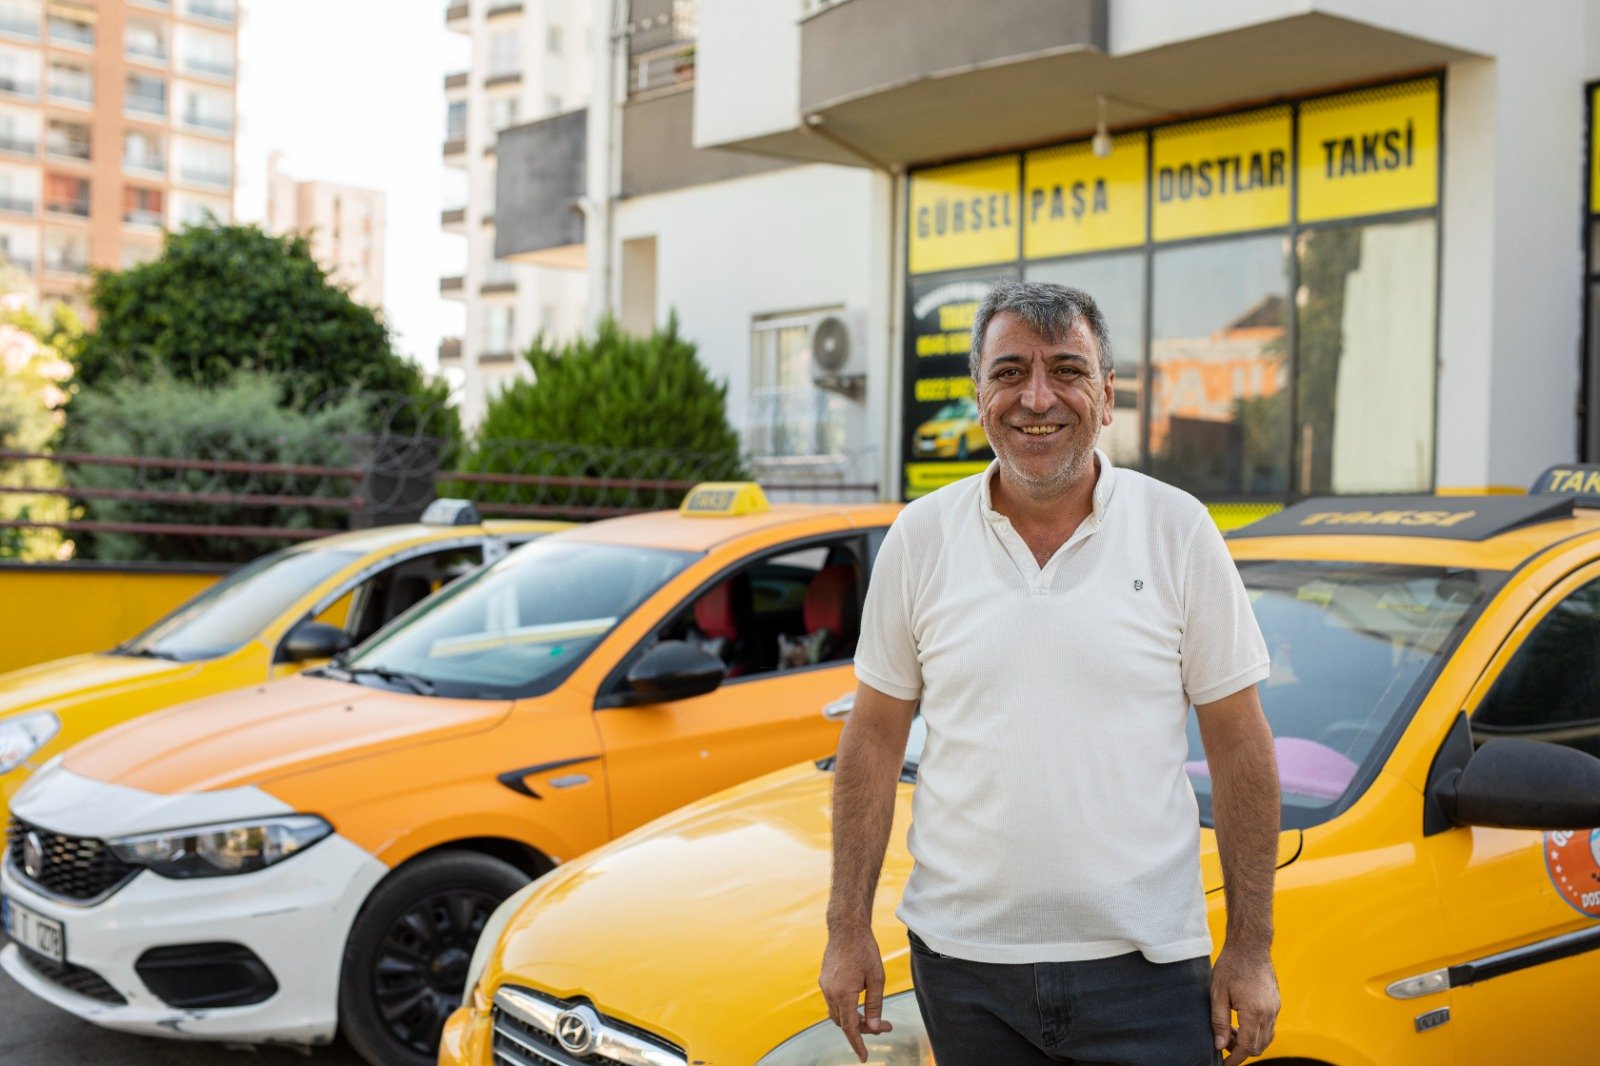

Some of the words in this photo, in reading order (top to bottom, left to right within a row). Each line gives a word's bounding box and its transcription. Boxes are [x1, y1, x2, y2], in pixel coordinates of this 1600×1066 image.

[917, 192, 1012, 239] GÜRSEL
[1031, 179, 1108, 224] PAŞA
[1158, 149, 1286, 203] DOSTLAR
[1321, 118, 1415, 179] TAKSİ
